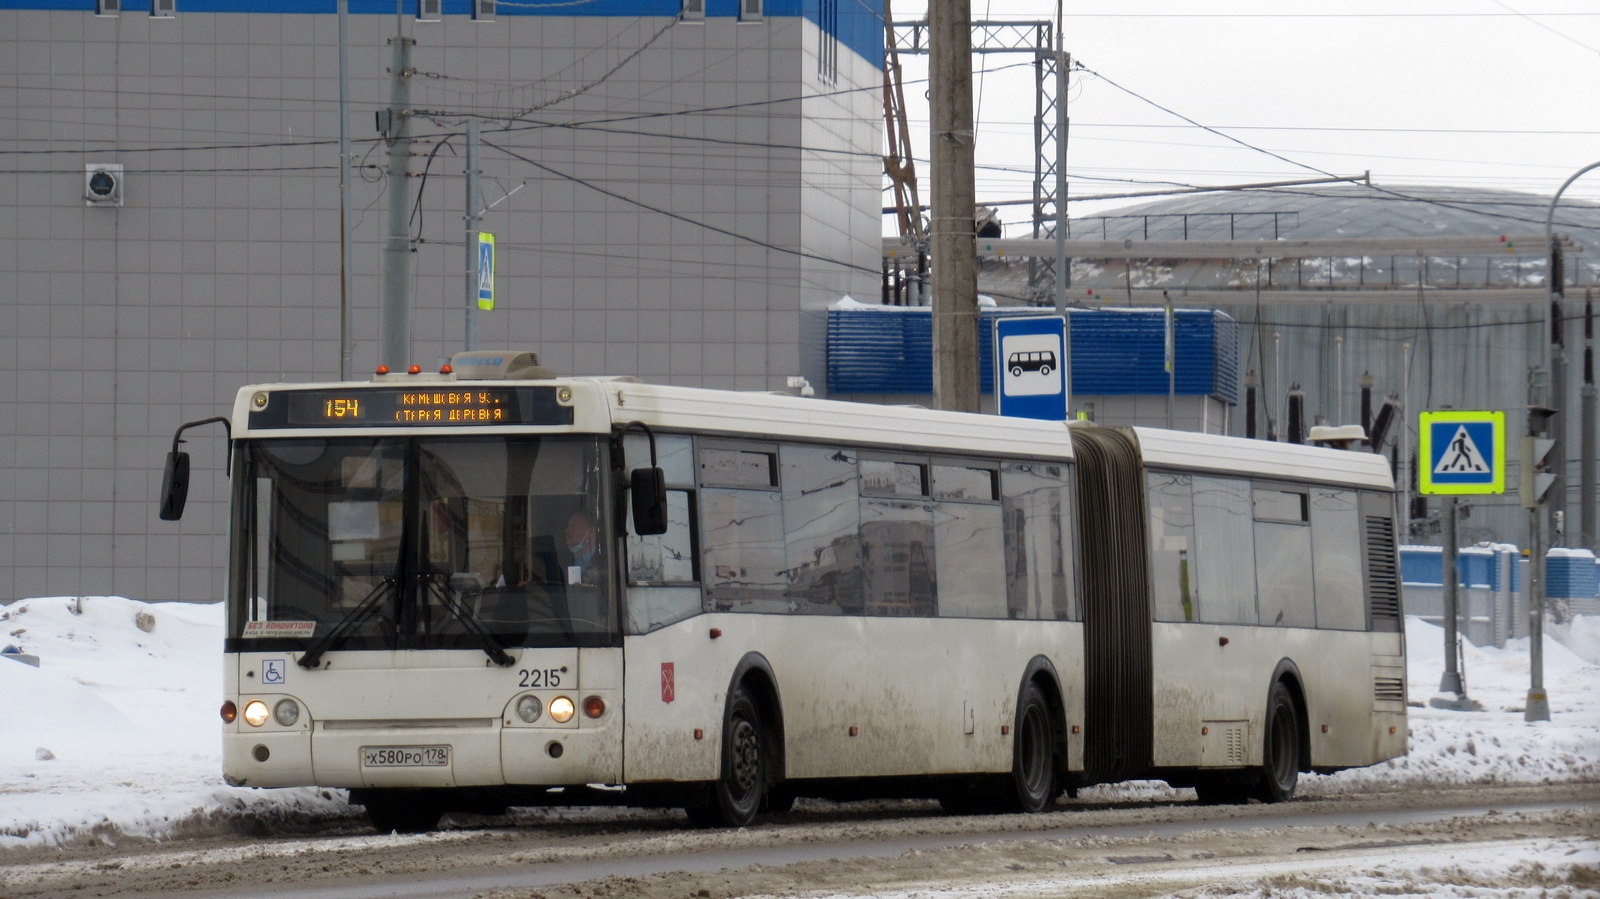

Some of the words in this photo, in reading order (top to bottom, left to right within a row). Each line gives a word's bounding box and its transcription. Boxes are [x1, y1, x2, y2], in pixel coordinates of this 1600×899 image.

[326, 400, 359, 417] 154
[248, 622, 262, 630] БЕЗ
[266, 622, 314, 630] КОНДУКТОРА
[519, 669, 561, 687] 2215
[424, 749, 444, 760] 178
